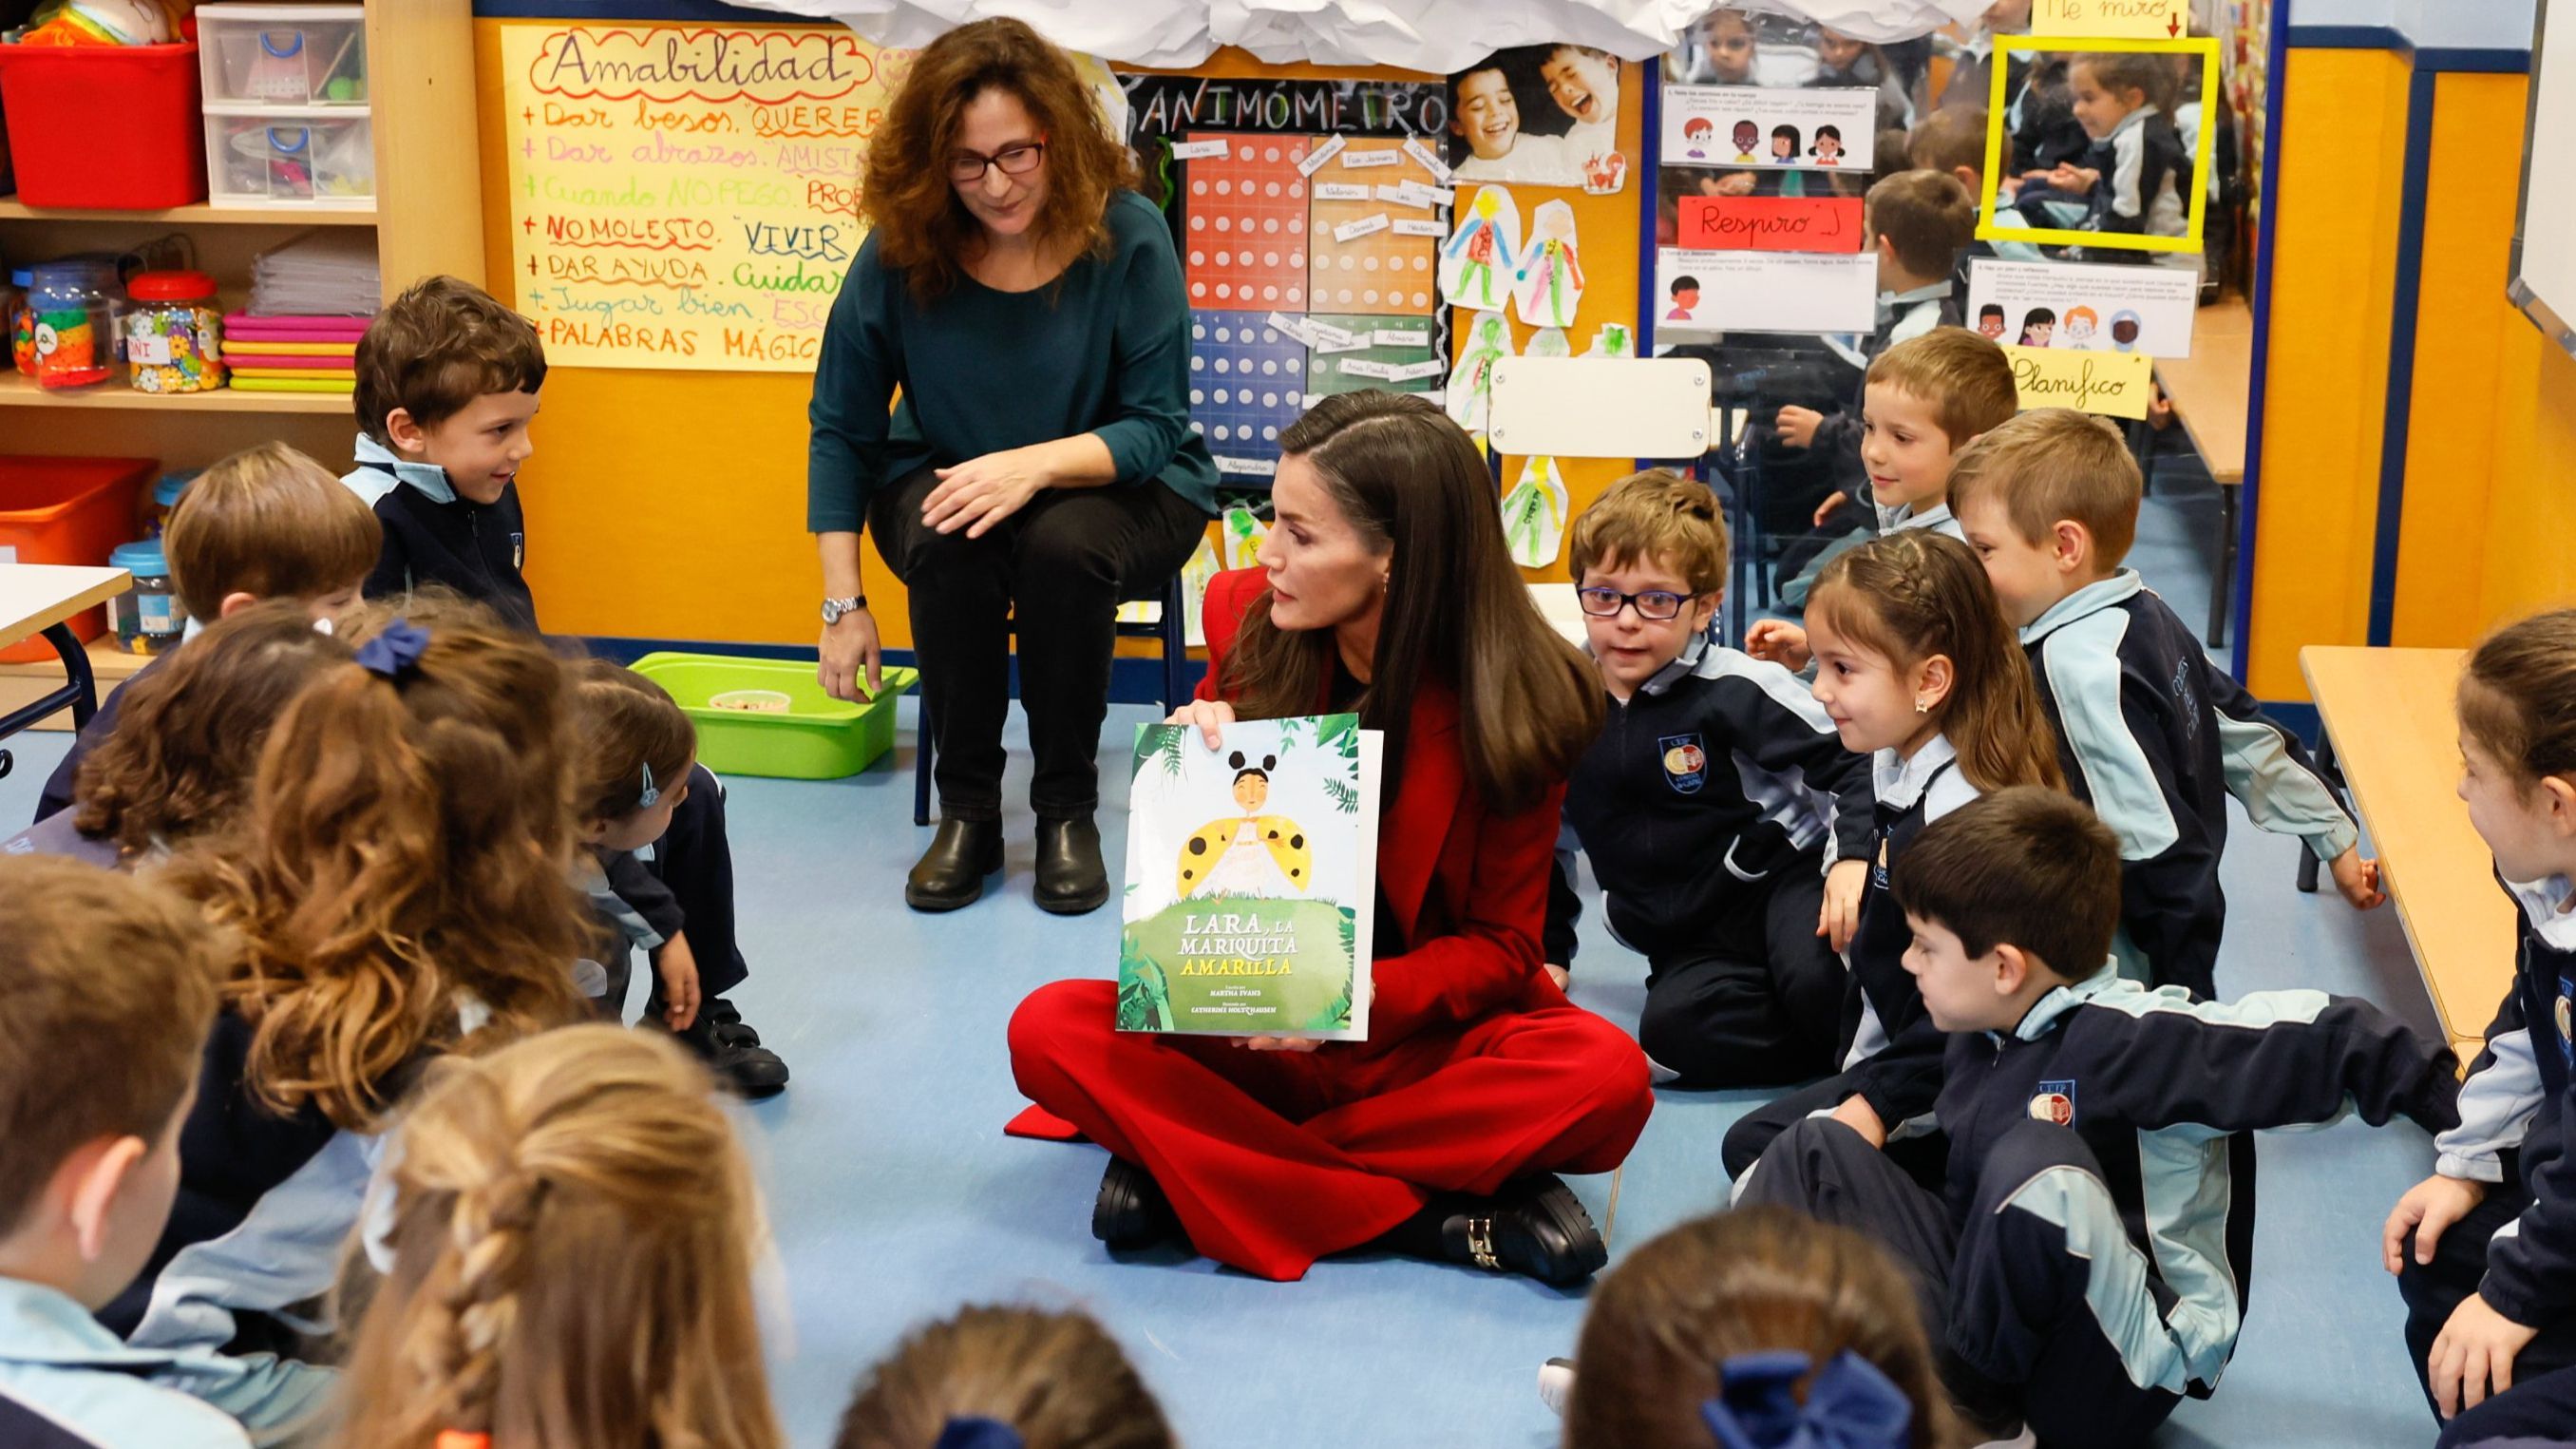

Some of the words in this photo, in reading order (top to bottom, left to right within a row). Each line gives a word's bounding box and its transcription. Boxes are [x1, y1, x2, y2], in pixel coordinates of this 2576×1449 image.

[550, 33, 854, 86] Amabilidad
[543, 101, 614, 128] Dar
[1140, 79, 1448, 134] ANIMÓMETRO
[546, 135, 614, 163] Dar
[543, 175, 657, 208] Cuando
[547, 255, 599, 276] DAR
[550, 287, 664, 331] Jugar
[550, 317, 699, 356] PALABRAS
[1274, 920, 1295, 934] LA
[1177, 937, 1298, 962] MARIQUITA
[1180, 958, 1293, 977] AMARILLA
